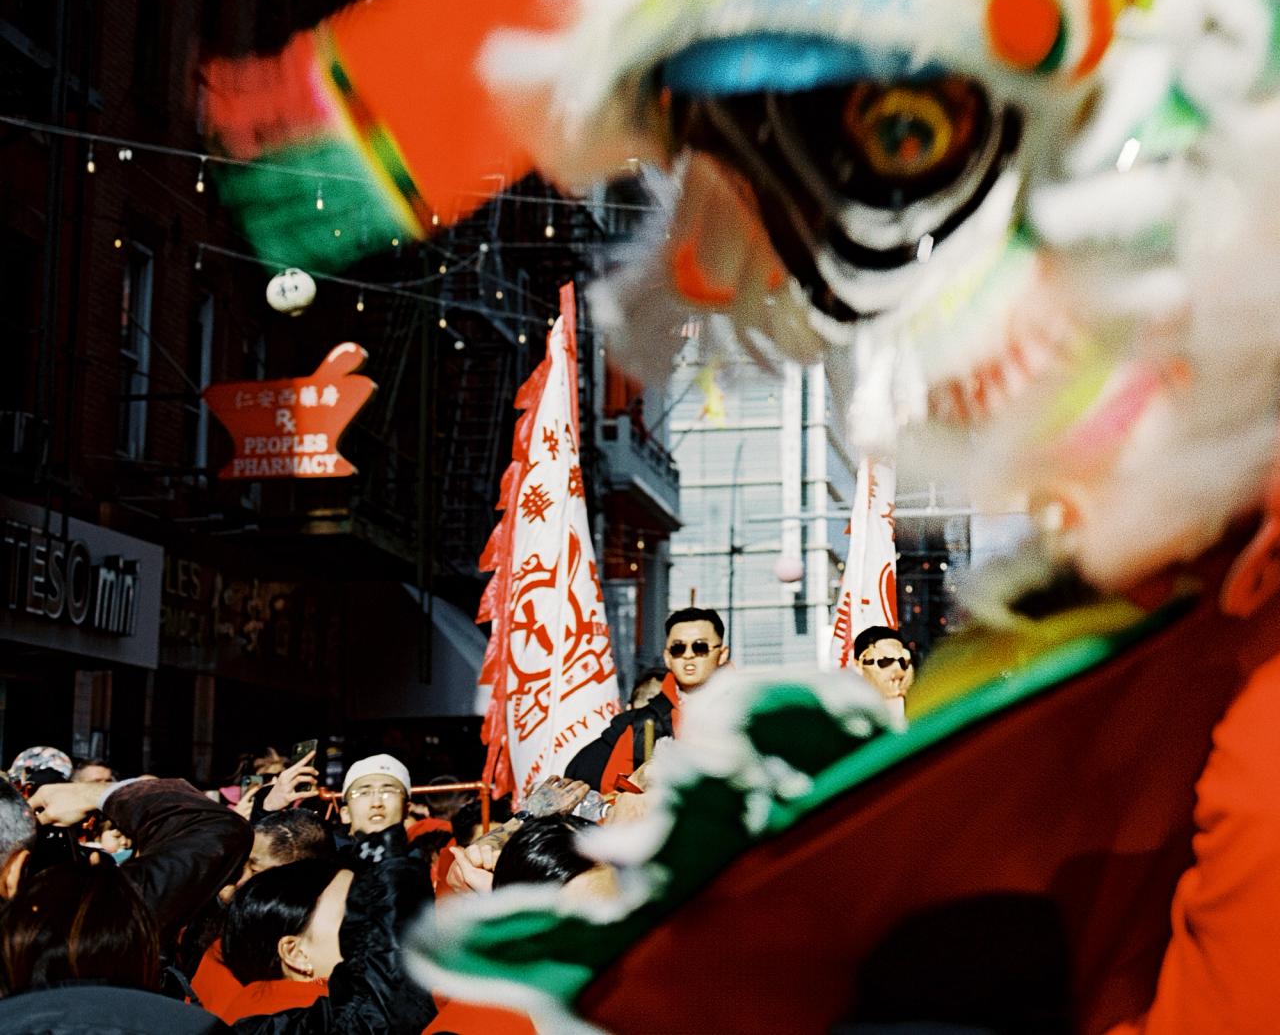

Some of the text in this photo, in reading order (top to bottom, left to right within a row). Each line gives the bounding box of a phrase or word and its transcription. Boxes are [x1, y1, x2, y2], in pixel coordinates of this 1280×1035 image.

[244, 433, 328, 455] PEOPLES
[231, 453, 338, 477] PHARMACY
[4, 520, 92, 626] TESO
[94, 555, 140, 638] mini
